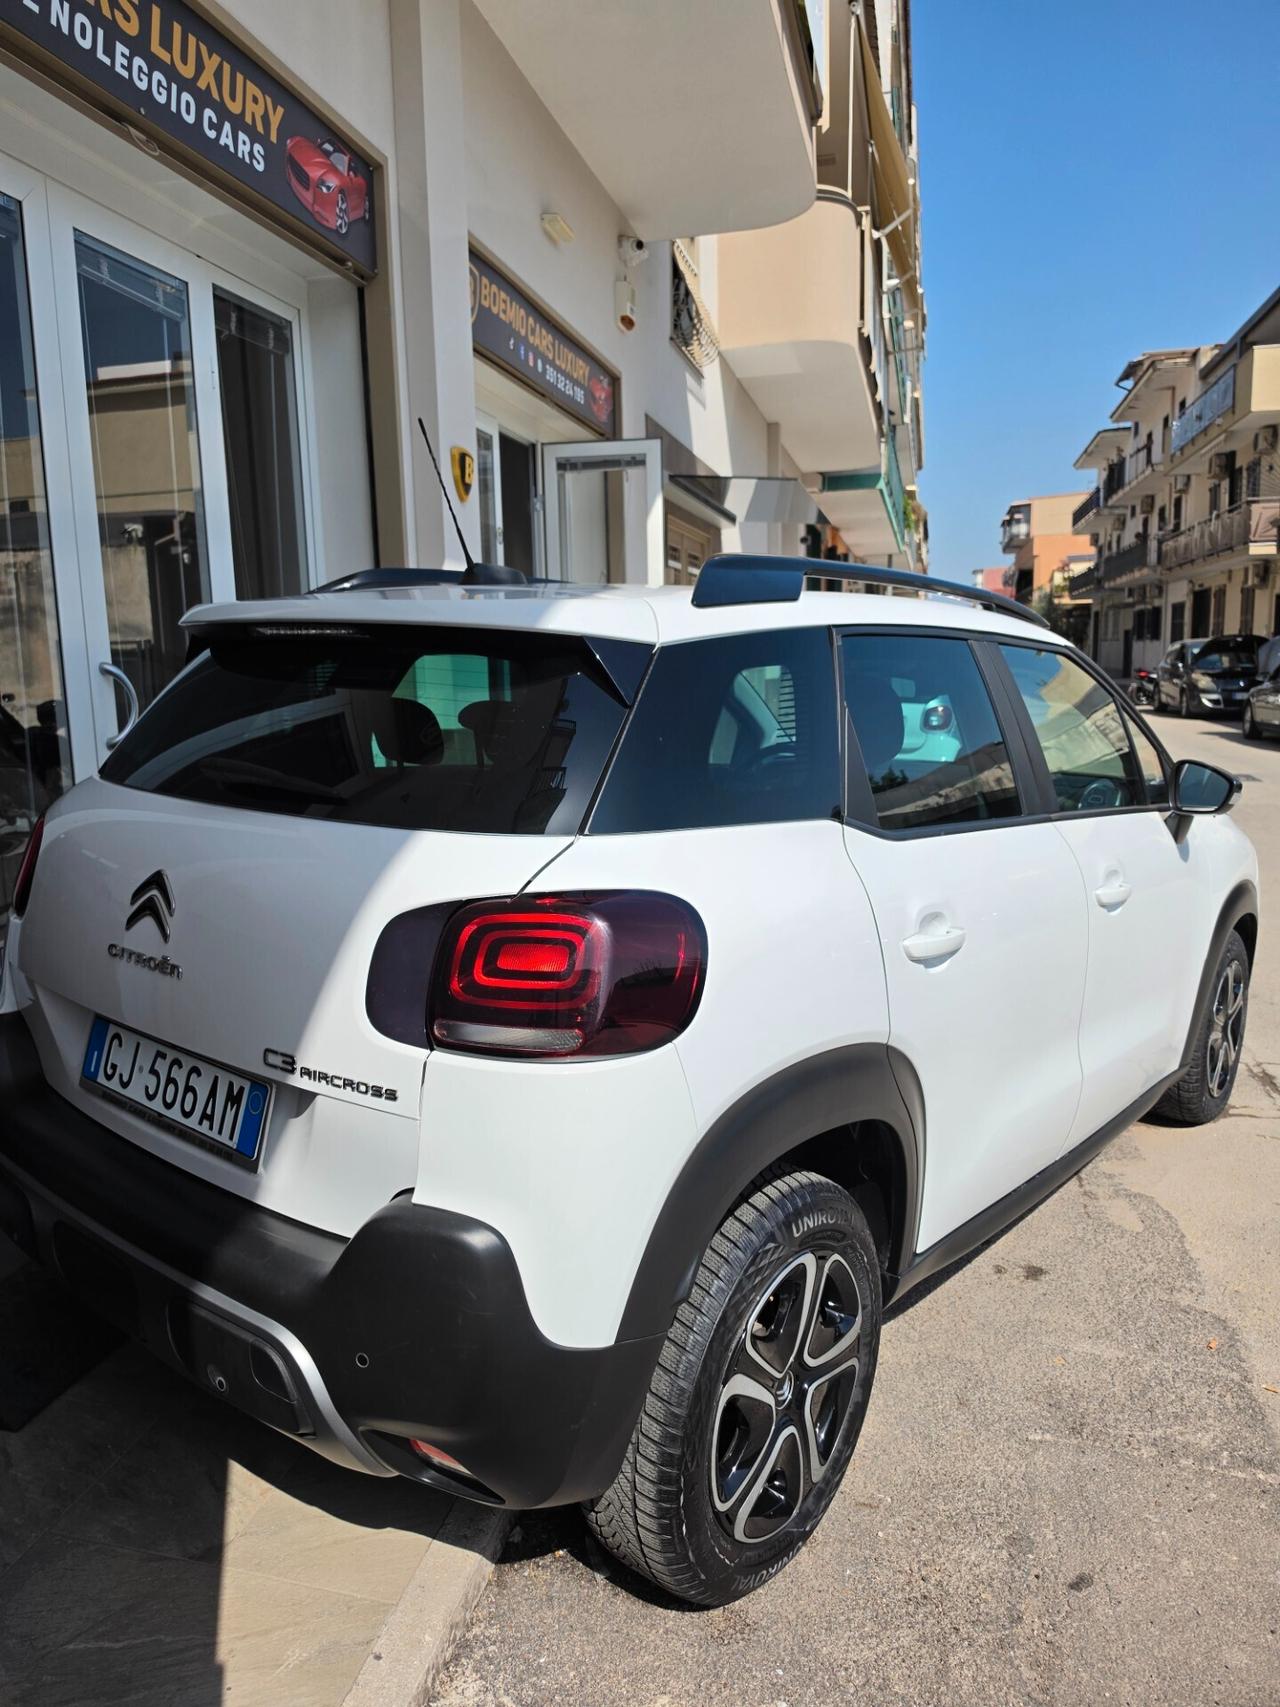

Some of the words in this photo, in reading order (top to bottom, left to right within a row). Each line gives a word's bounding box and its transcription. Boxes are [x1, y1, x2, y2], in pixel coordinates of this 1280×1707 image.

[50, 0, 196, 125] NOLEGGIO
[203, 108, 265, 172] CARS
[150, 4, 285, 144] LUXURY
[480, 275, 526, 337] BOEMIO
[528, 315, 554, 361] CARS
[555, 338, 590, 388] LUXURY
[263, 1047, 297, 1075] C3
[299, 1066, 398, 1102] AIRCROSS
